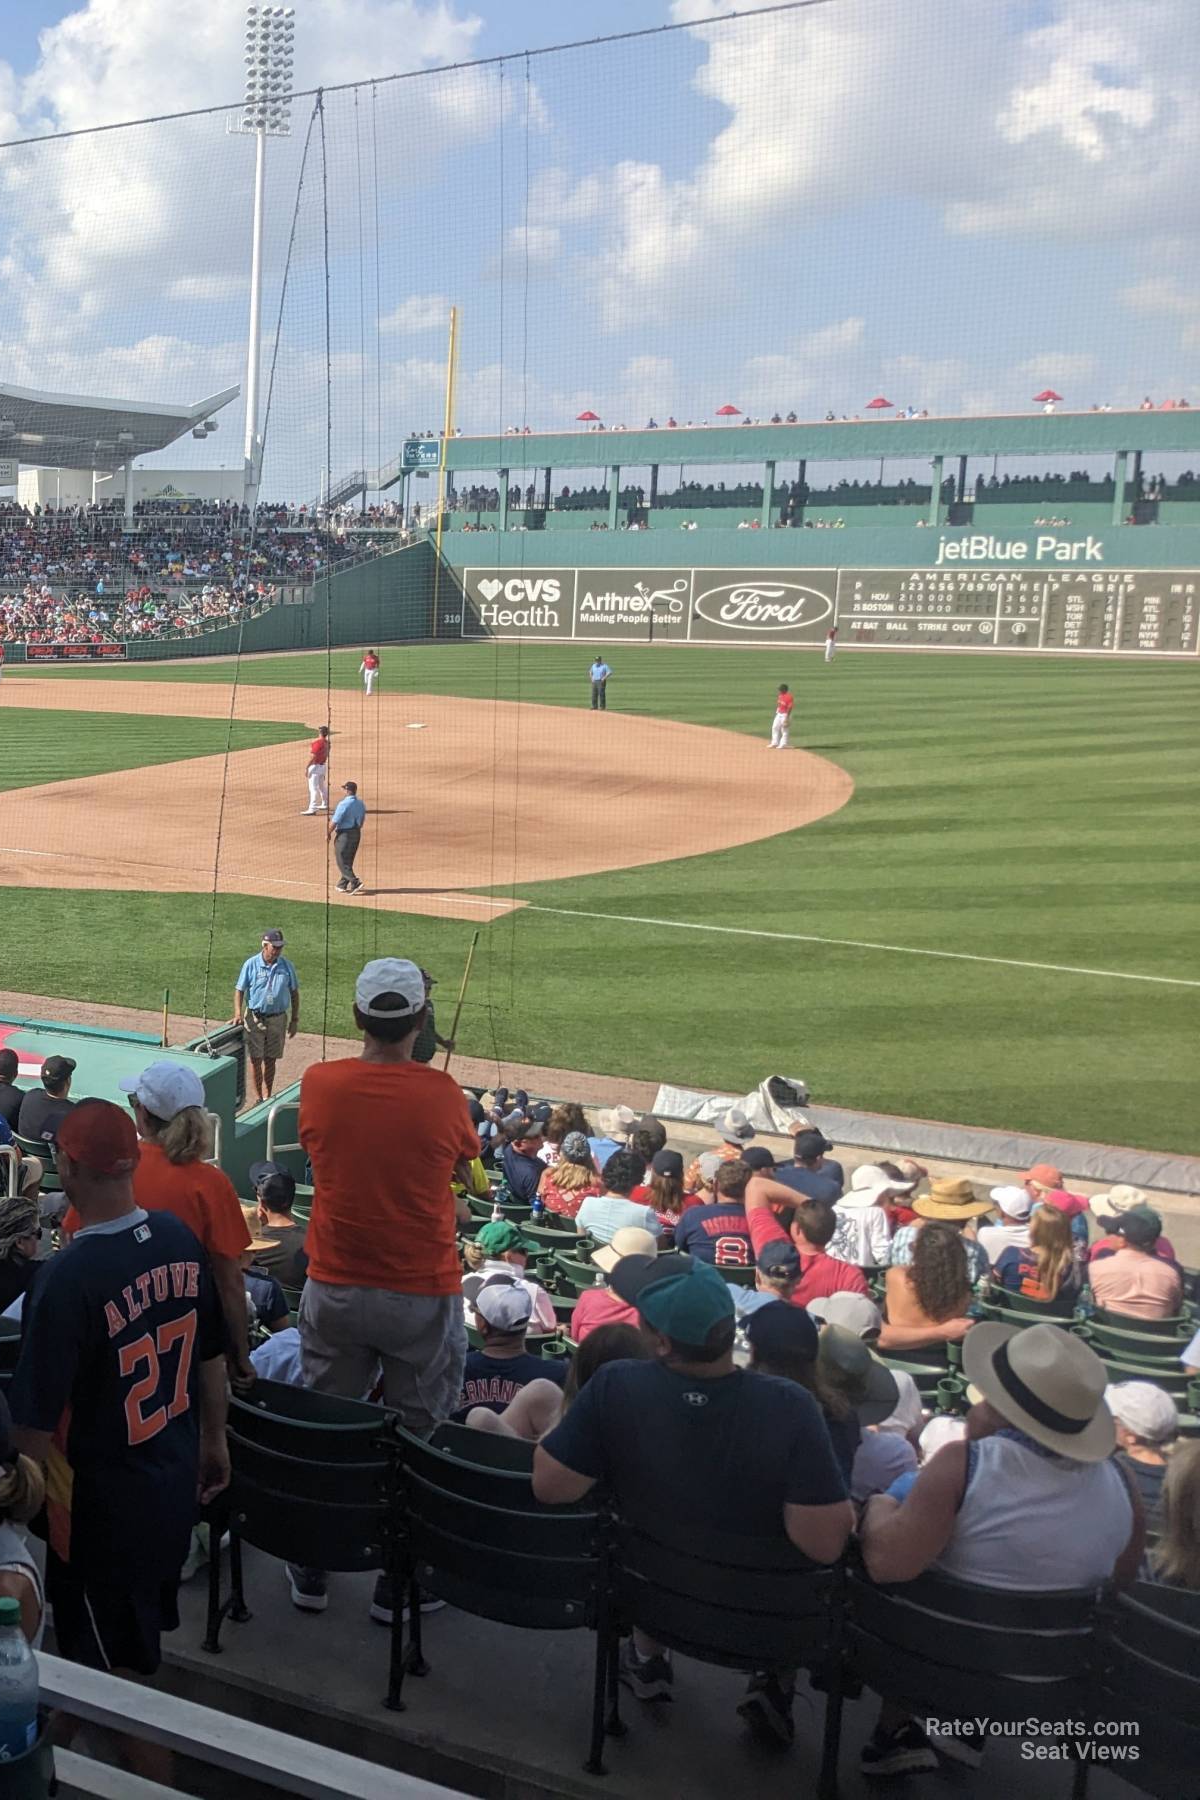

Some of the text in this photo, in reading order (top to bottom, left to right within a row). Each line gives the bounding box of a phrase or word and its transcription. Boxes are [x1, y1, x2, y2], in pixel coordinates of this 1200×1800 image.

[935, 536, 1103, 565] jetBlue Park
[909, 573, 1135, 583] AMERICAN LEAGUE
[504, 578, 561, 602] CVS
[580, 591, 655, 612] Arthrex
[720, 588, 806, 623] Ford
[862, 604, 894, 612] BOSTON
[444, 614, 460, 624] 310
[479, 604, 560, 627] Health
[580, 614, 682, 624] Making People Better
[851, 622, 862, 630] AT
[863, 622, 879, 630] BAT
[886, 622, 908, 630] BALL
[917, 623, 948, 632] STRIKE
[952, 624, 972, 632] OUT
[104, 1262, 200, 1338] ALTUVE
[118, 1308, 198, 1446] 27
